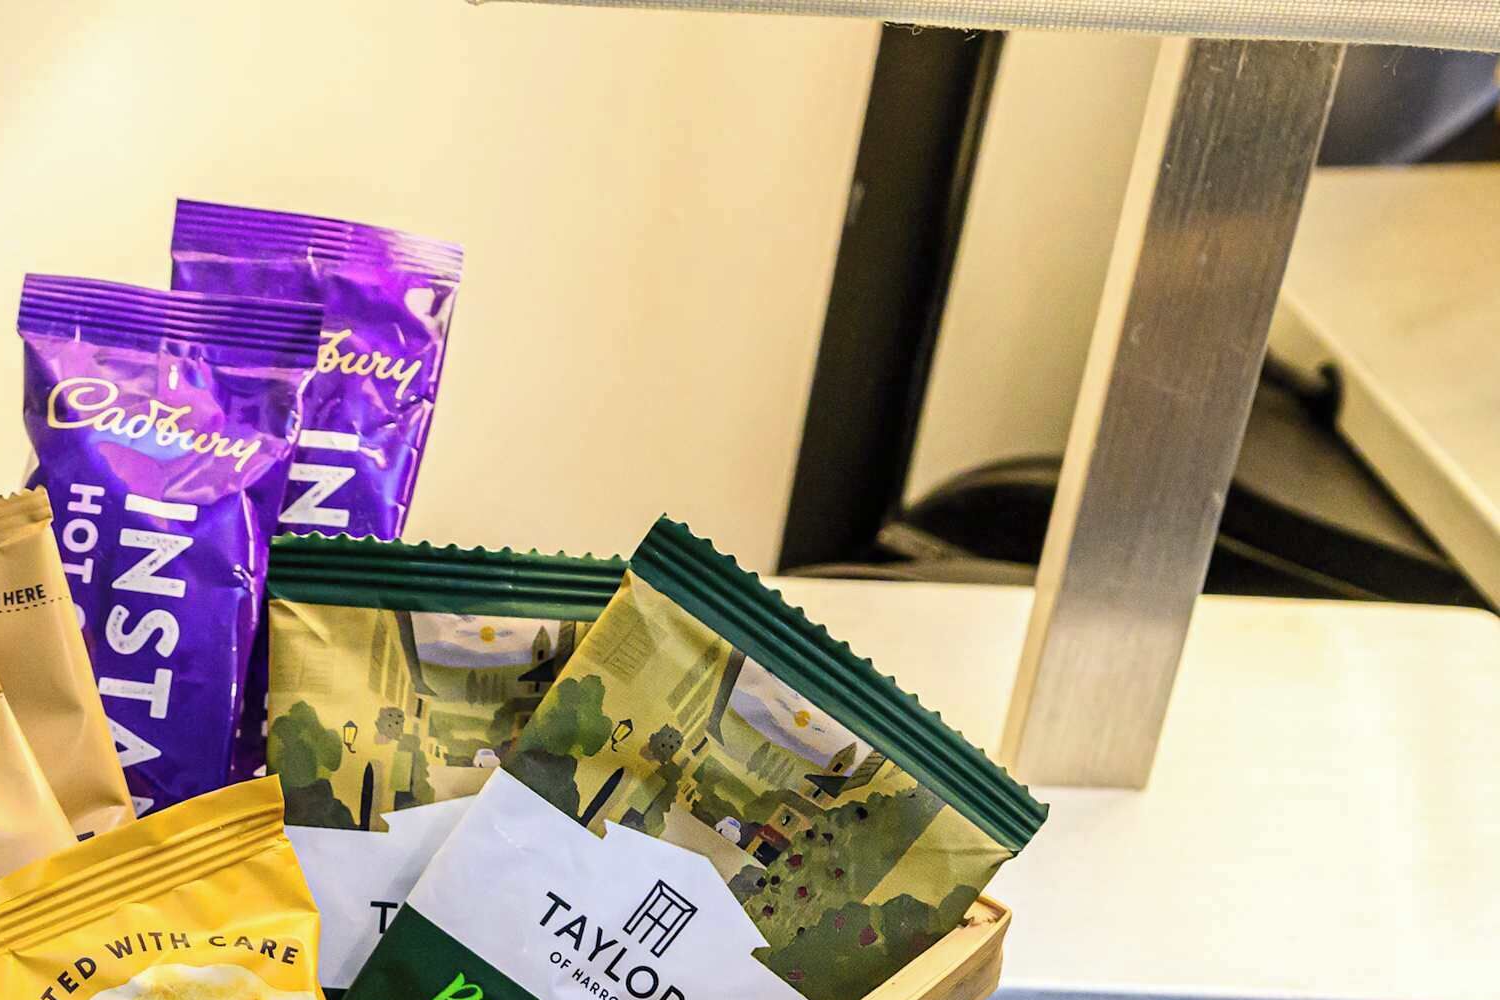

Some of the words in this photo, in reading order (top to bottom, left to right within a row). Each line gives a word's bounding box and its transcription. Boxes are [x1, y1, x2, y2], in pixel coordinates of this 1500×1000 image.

[47, 377, 262, 473] Cadbury
[62, 483, 106, 585] HOT
[3, 584, 47, 606] HERE
[98, 494, 198, 820] INSTA
[104, 932, 191, 960] WITH
[208, 935, 299, 965] CARE
[549, 951, 572, 970] OF
